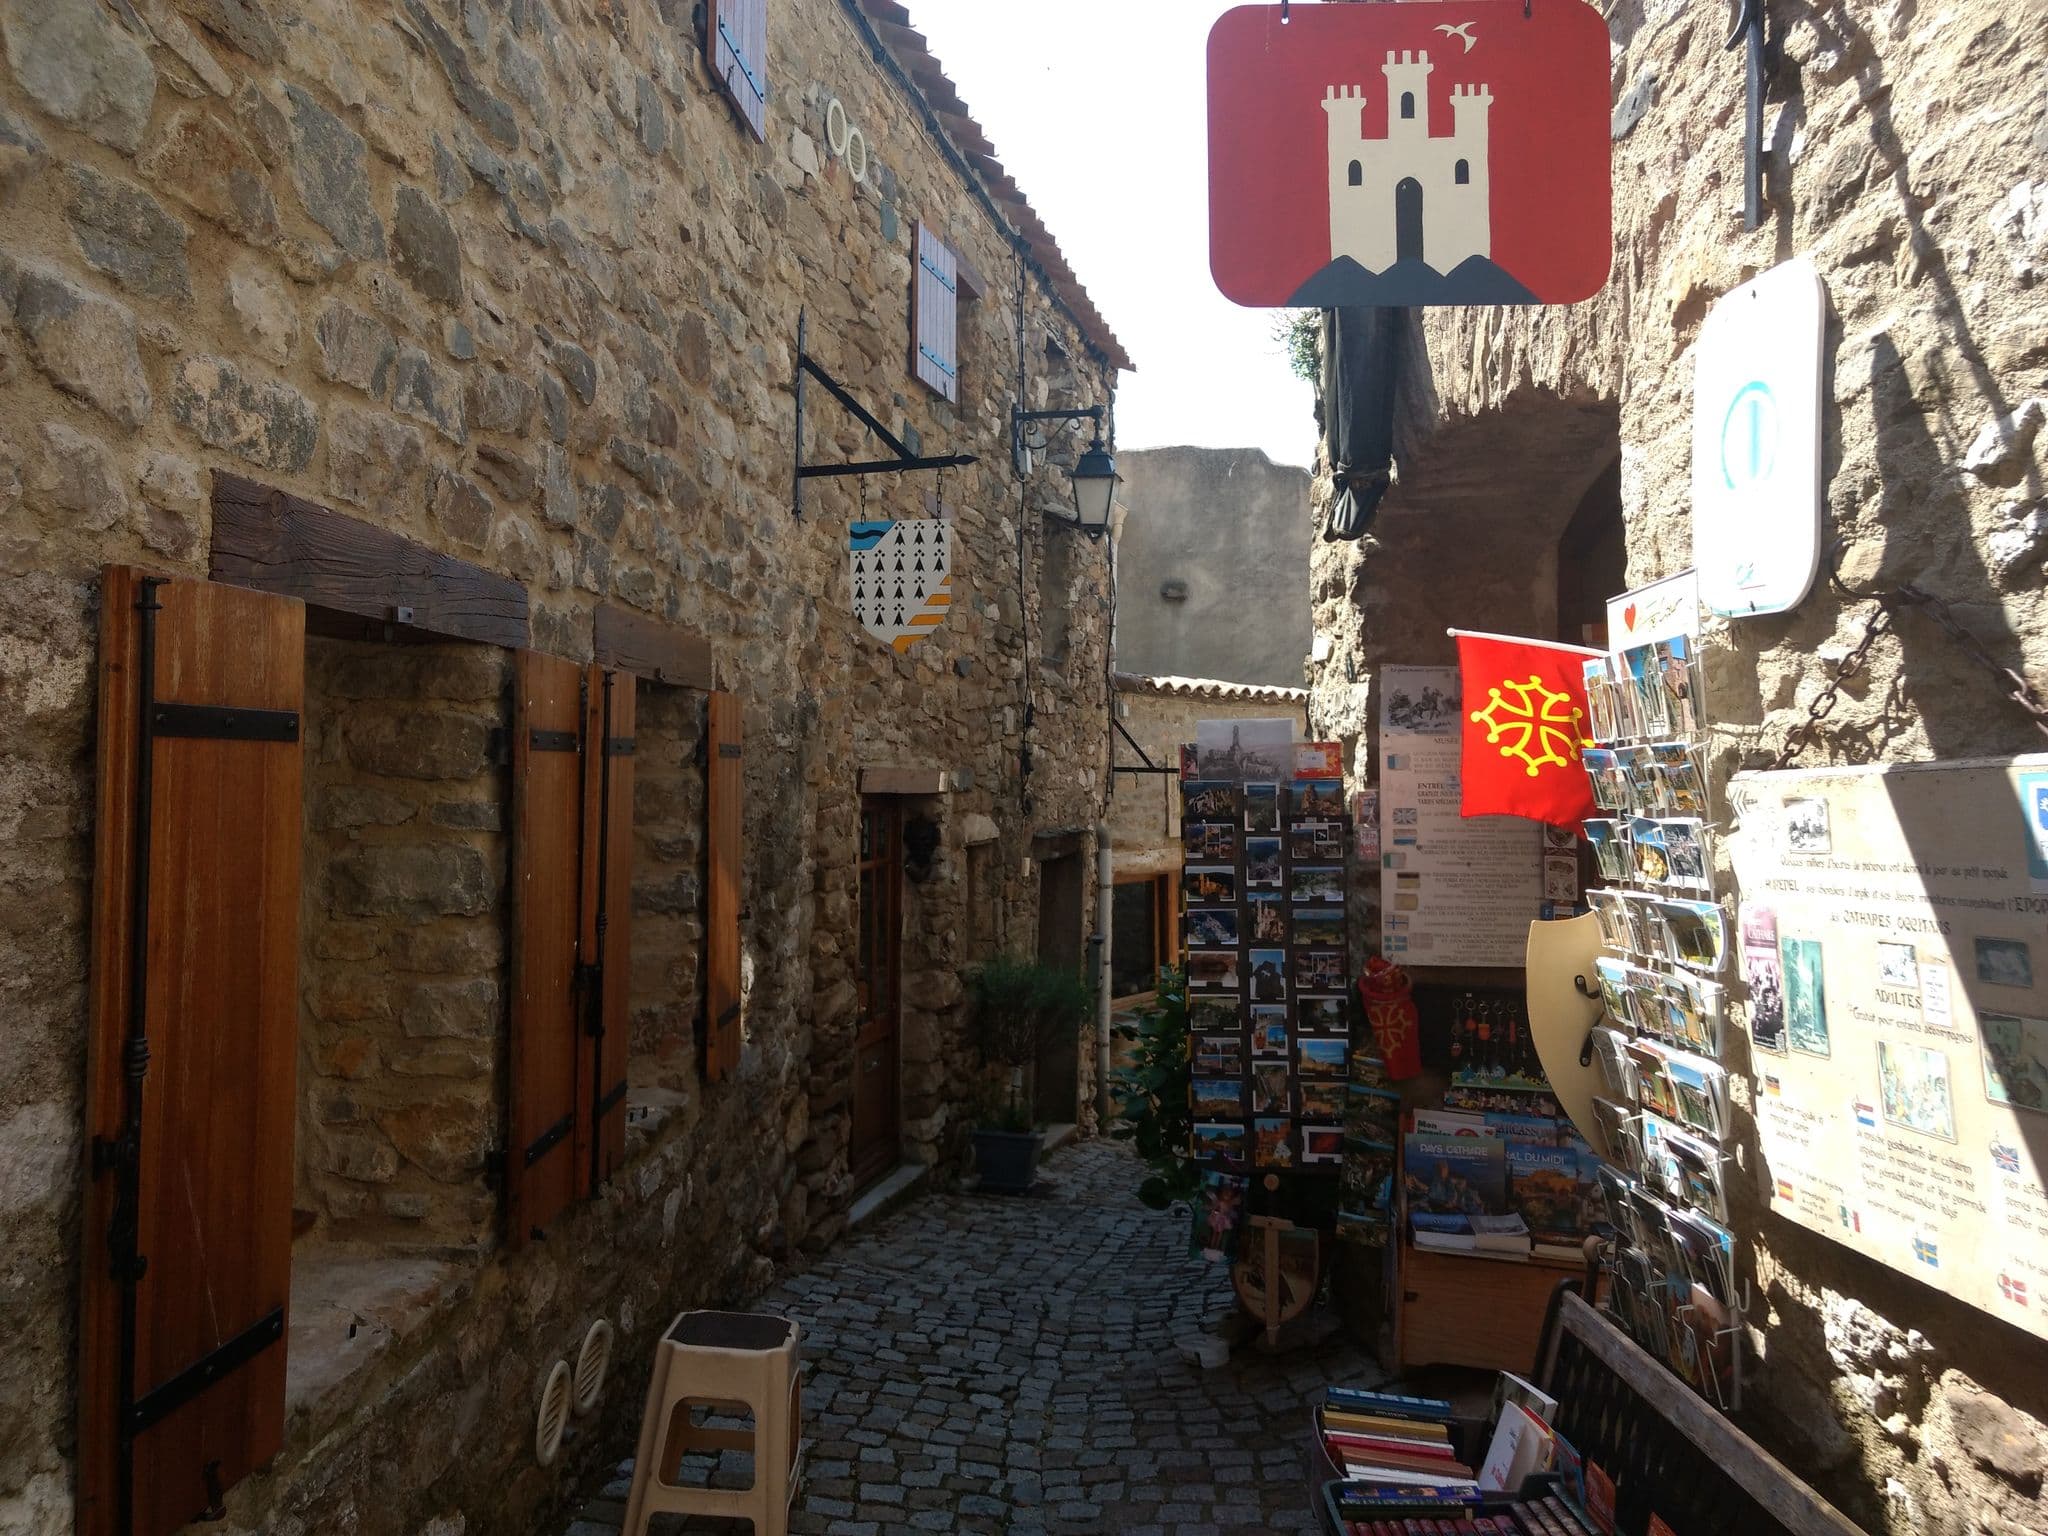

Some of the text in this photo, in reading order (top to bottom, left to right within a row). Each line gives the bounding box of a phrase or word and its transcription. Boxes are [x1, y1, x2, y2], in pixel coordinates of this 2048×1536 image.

[1419, 1143, 1442, 1154] PAYS
[1446, 1144, 1488, 1157] CATHARE
[1524, 1152, 1540, 1162] DU
[1541, 1154, 1565, 1165] MIDI
